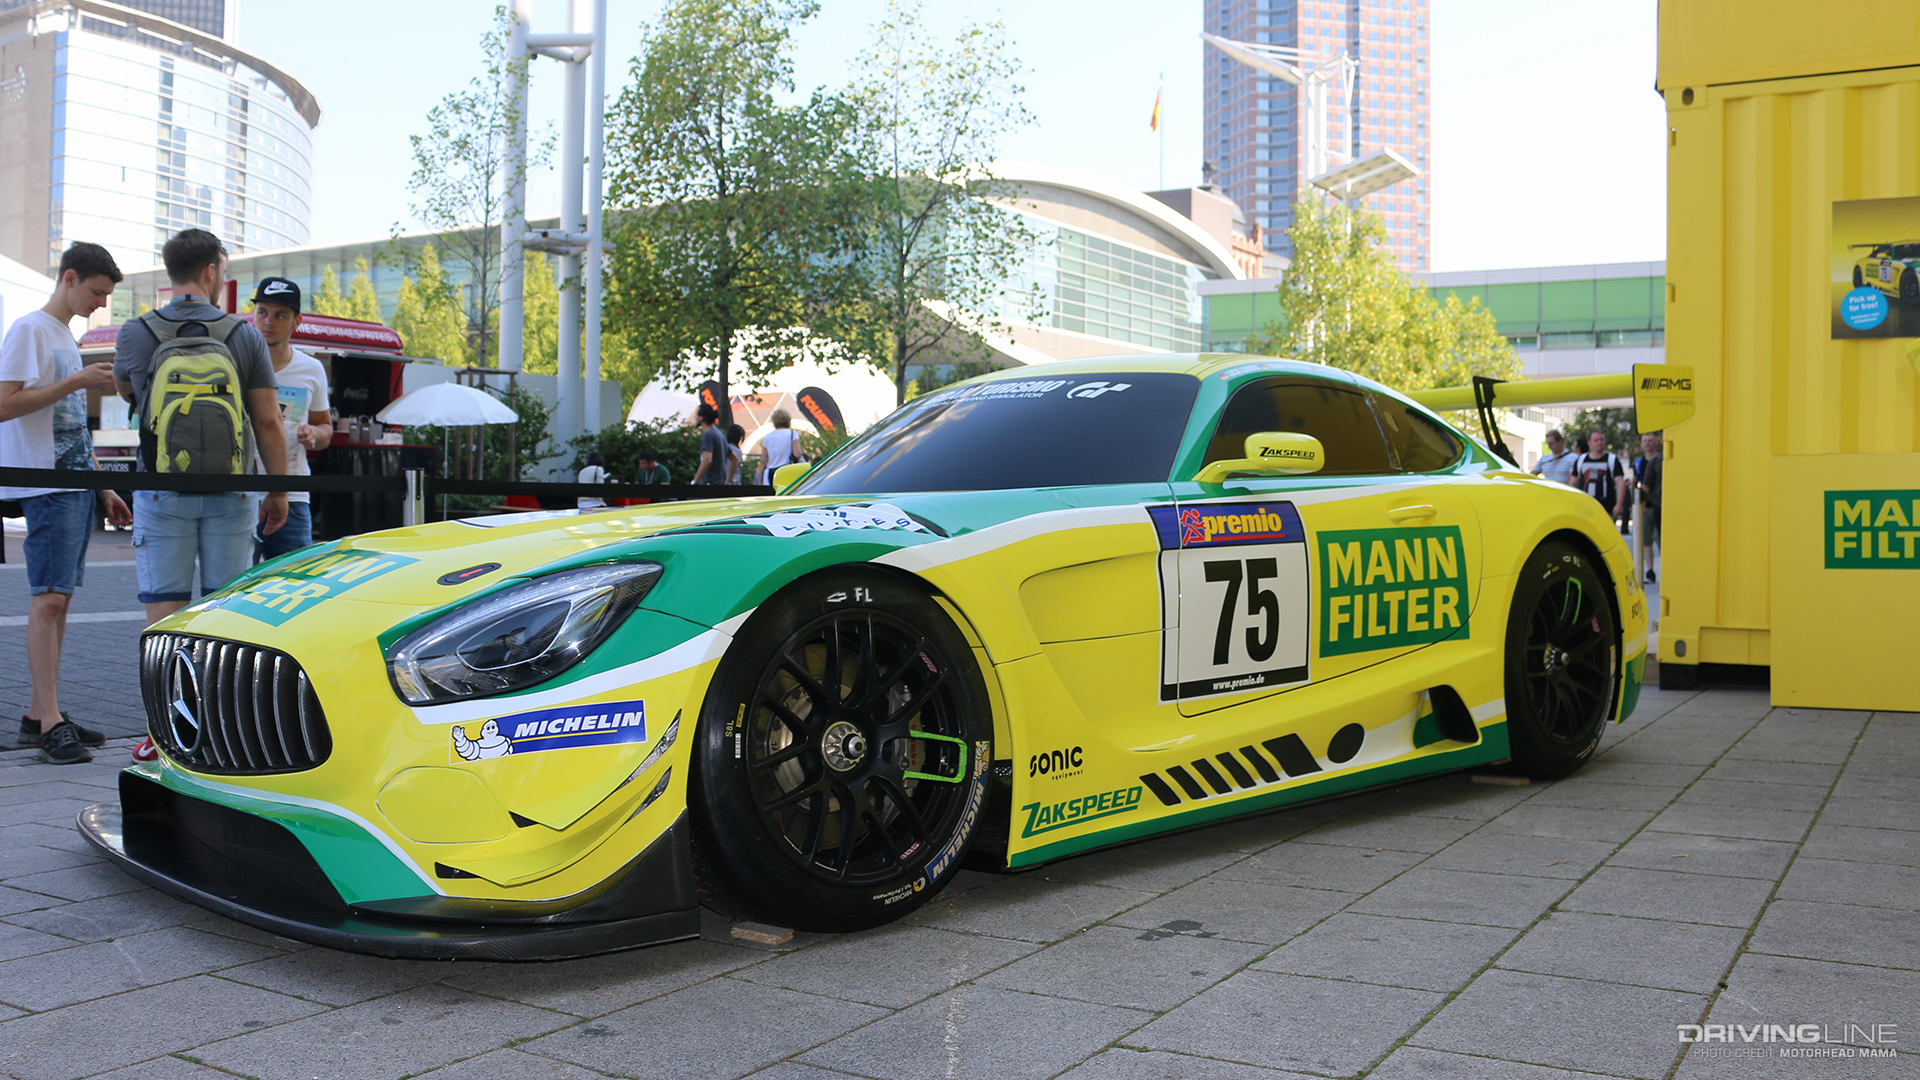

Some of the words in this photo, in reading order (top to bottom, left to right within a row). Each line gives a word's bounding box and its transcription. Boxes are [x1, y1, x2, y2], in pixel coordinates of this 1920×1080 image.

[1657, 378, 1692, 390] AMG
[1259, 447, 1316, 459] ZAKSPEED
[1202, 508, 1283, 542] premio
[1327, 536, 1458, 588] MANN
[854, 587, 873, 602] FL
[1203, 557, 1280, 666] 75
[1328, 586, 1461, 642] FILTER
[1213, 674, 1265, 691] www.premio.de
[514, 711, 642, 738] MICHELIN
[1052, 769, 1083, 781] equipment
[1021, 786, 1143, 839] ZAKSPEED
[932, 781, 985, 879] MICHELIN
